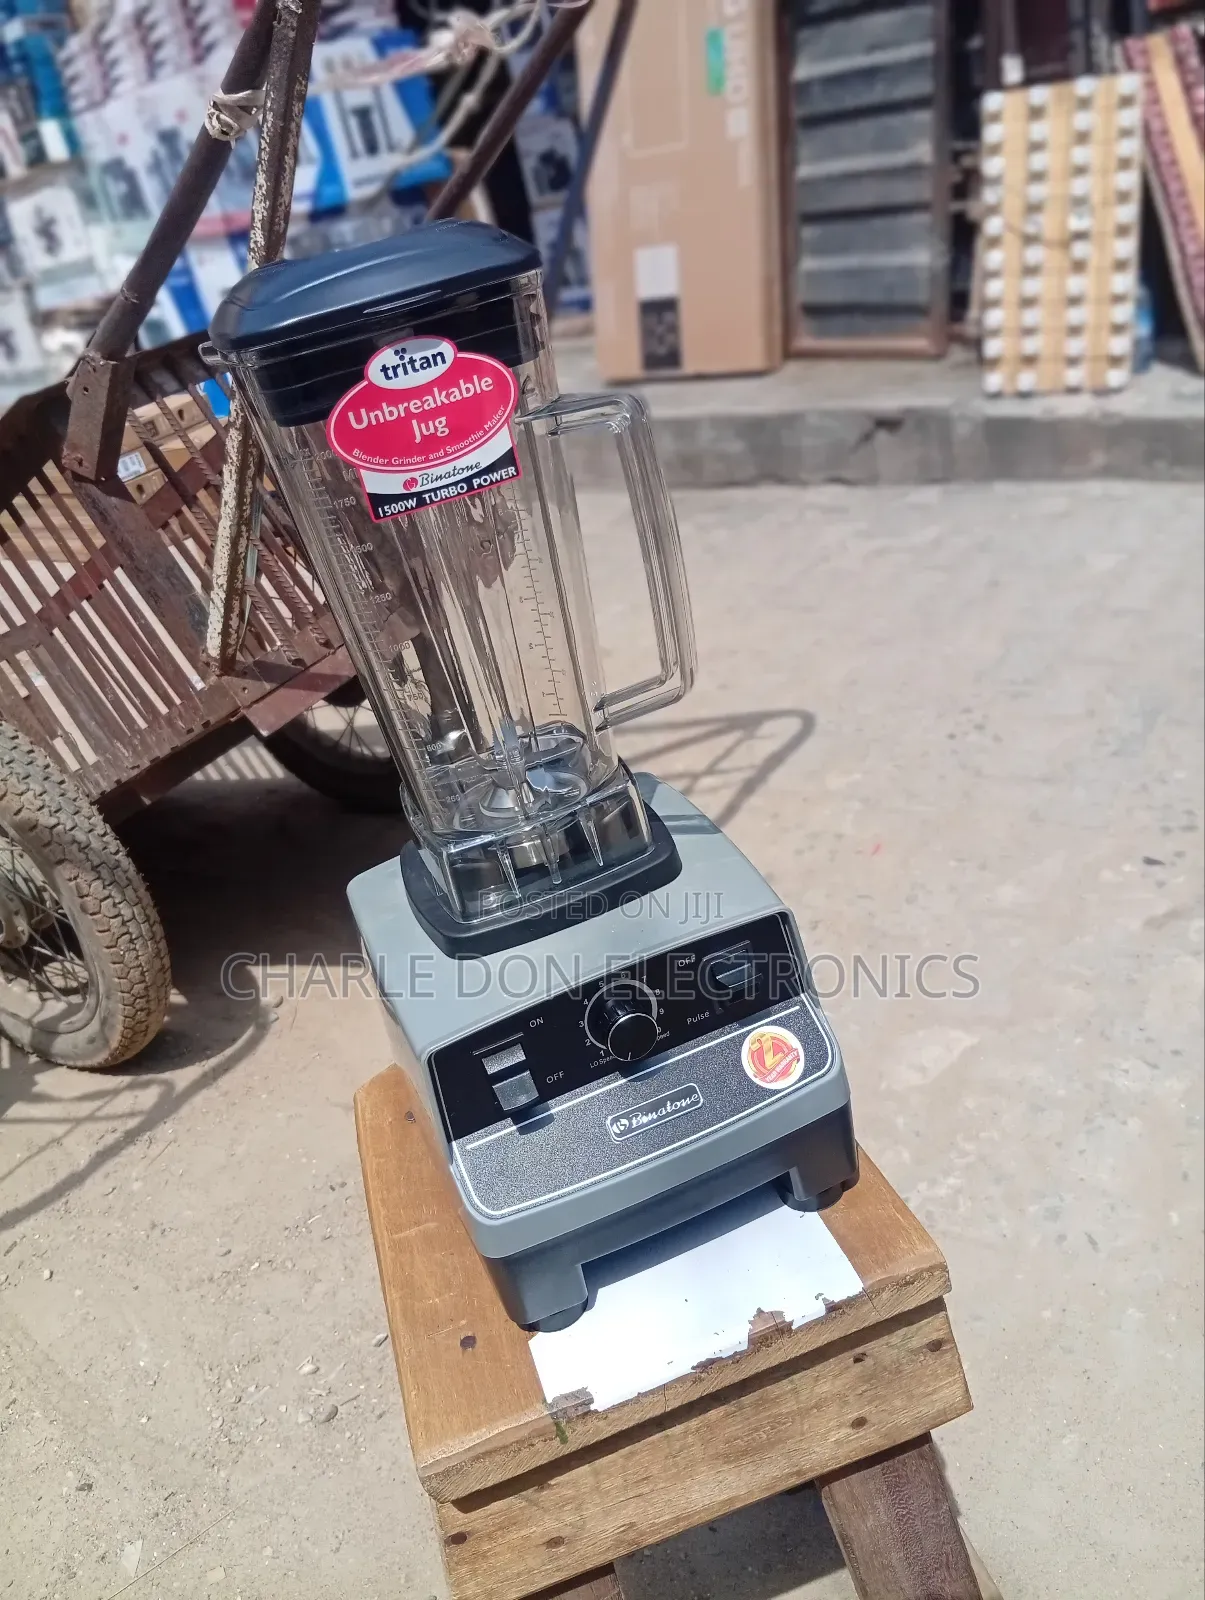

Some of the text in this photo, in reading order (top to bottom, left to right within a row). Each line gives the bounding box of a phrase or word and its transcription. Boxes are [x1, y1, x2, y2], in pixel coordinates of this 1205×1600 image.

[379, 347, 447, 381] tritan
[347, 375, 494, 430] Unbreakable
[352, 405, 505, 466] Blender Grinder and Smoothie Maker
[411, 416, 450, 444] Jug
[418, 461, 482, 486] Binatone
[378, 466, 517, 518] 1500W TURBO POWER
[678, 955, 697, 968] OFF
[529, 1016, 544, 1028] ON
[686, 1010, 711, 1026] Pulse
[546, 1070, 565, 1084] OFF
[631, 1093, 699, 1129] Binatone
